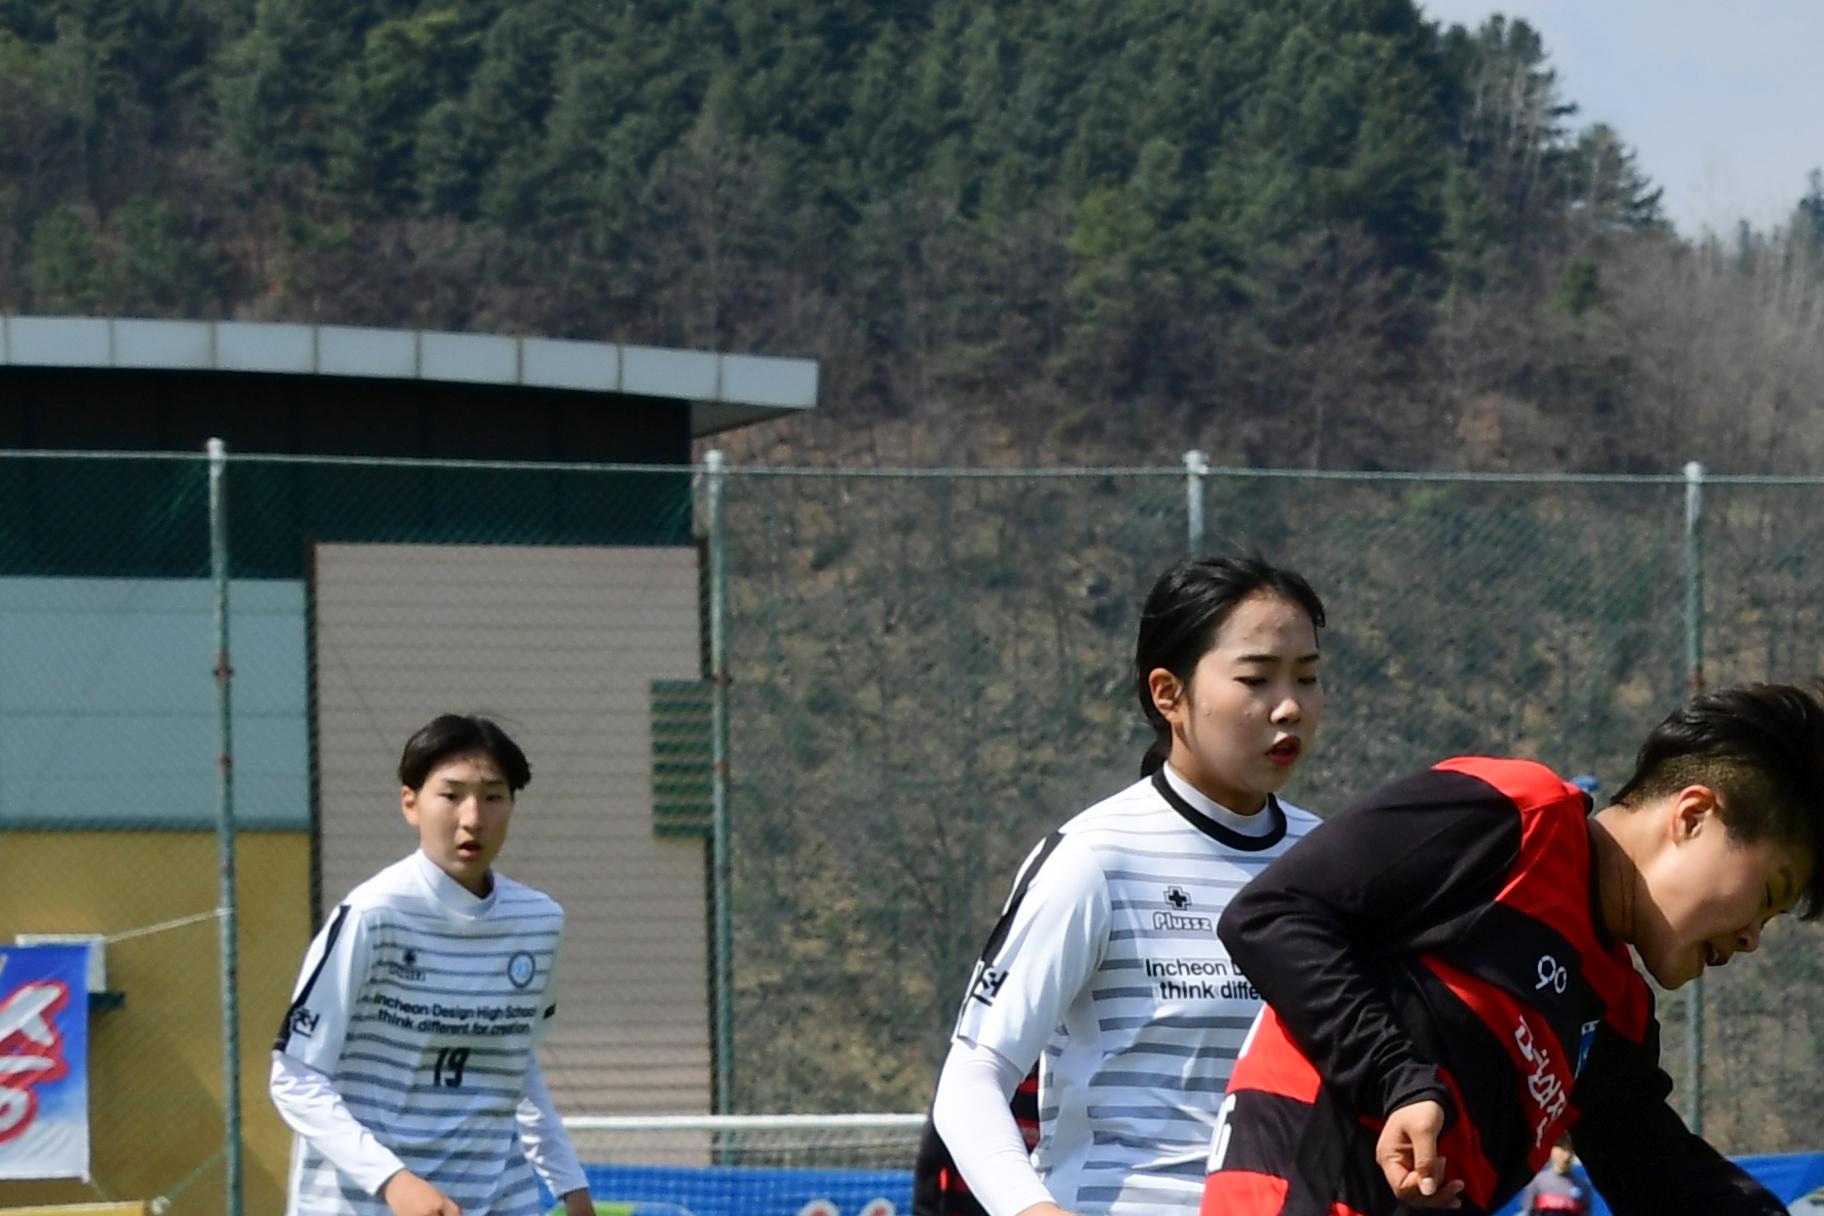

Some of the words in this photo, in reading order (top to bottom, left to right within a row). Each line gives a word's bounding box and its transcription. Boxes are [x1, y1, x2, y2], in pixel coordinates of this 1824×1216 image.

[1145, 958, 1228, 977] Incheon
[1160, 980, 1216, 1000] think
[1220, 980, 1261, 1000] diffe
[374, 993, 428, 1015] Incheon
[432, 1003, 474, 1020] Design
[477, 1005, 504, 1021] High
[378, 1009, 413, 1029] think
[418, 1018, 470, 1034] different
[473, 1022, 489, 1035] for
[434, 1047, 471, 1088] 19
